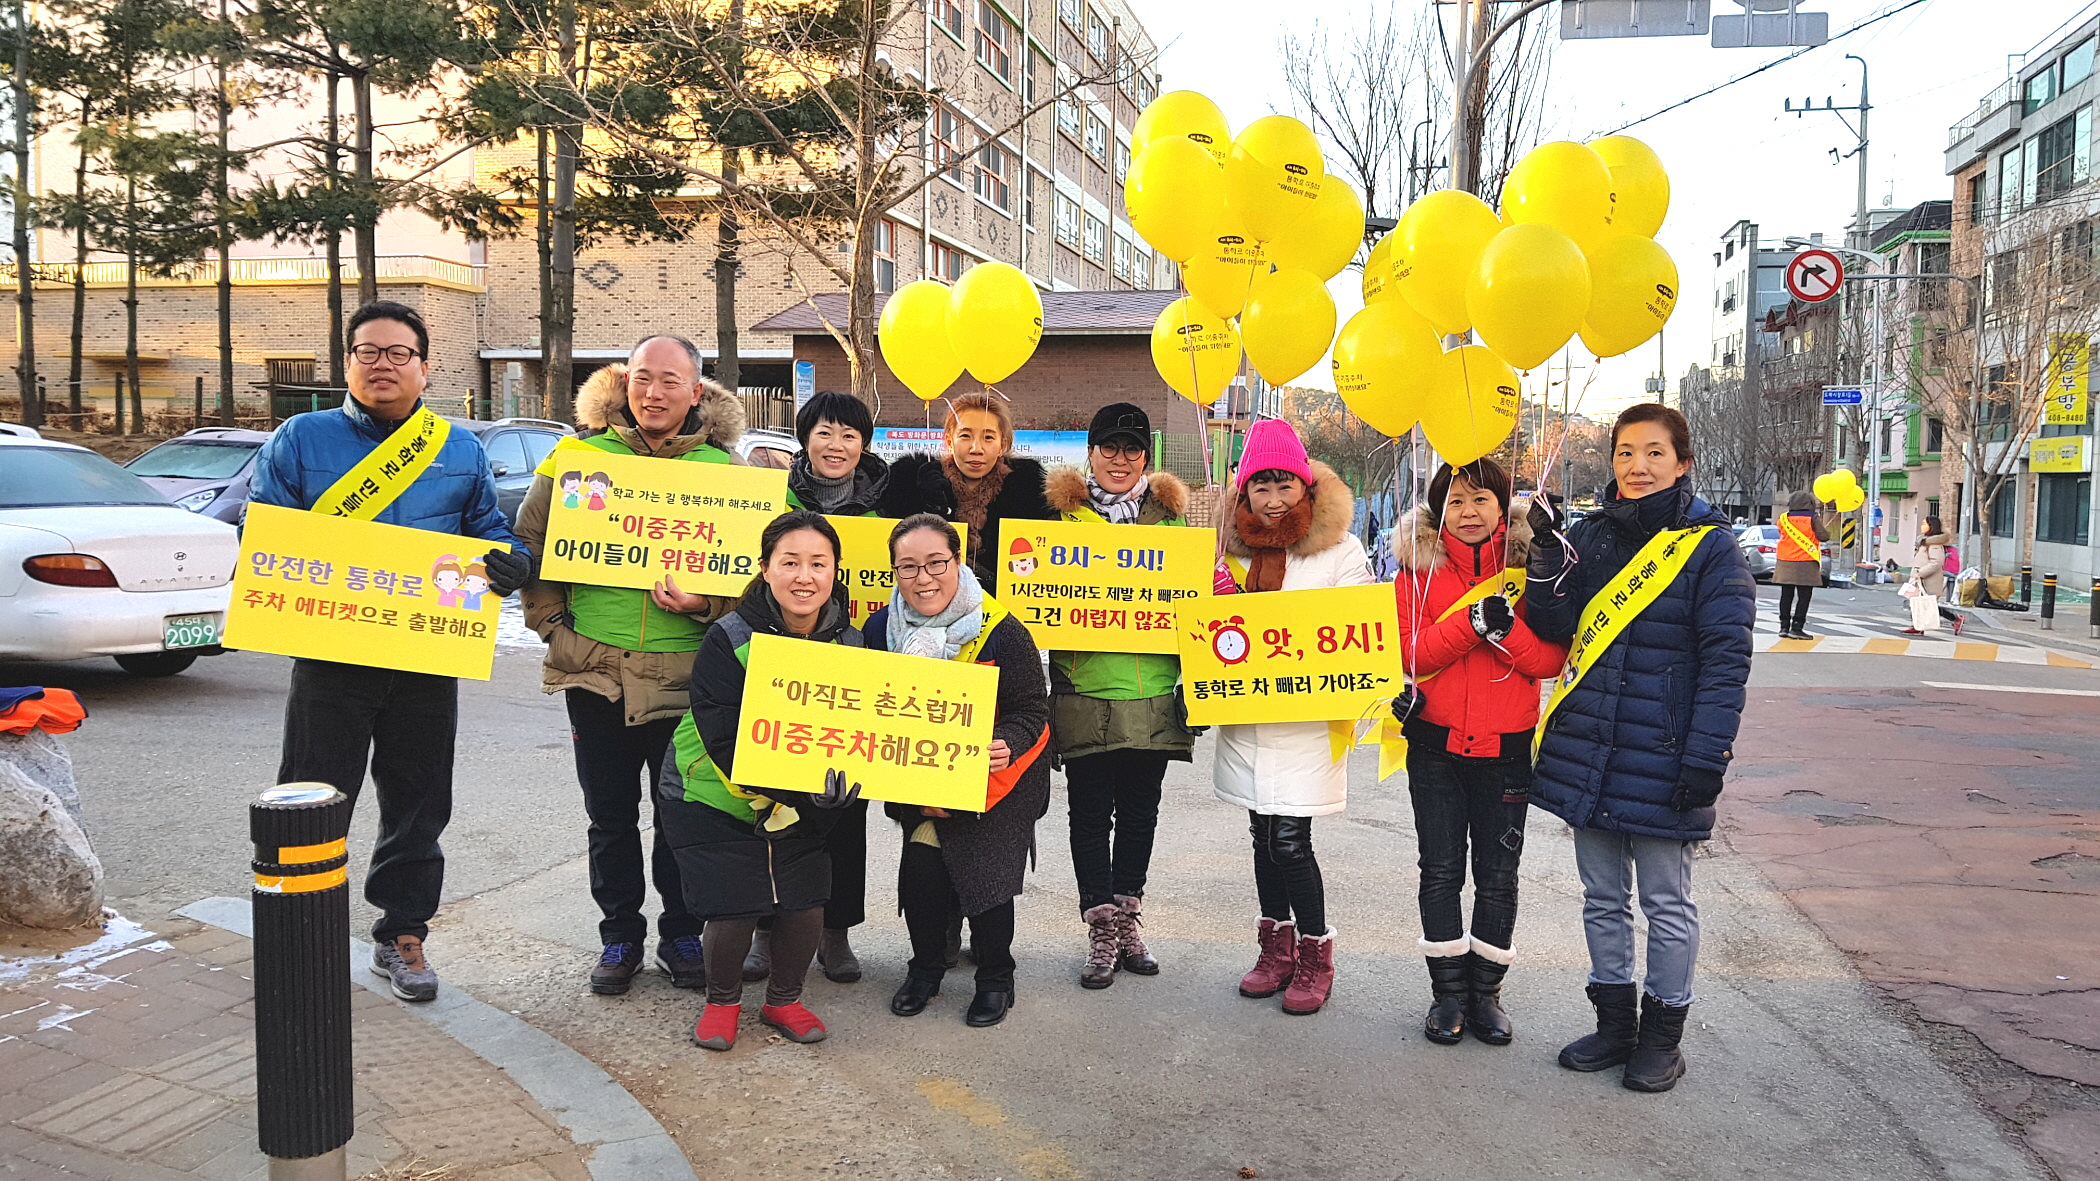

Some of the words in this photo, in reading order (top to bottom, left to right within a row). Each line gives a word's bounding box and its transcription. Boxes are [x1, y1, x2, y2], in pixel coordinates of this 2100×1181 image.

[379, 434, 428, 480] 통학로
[612, 487, 635, 500] 학교
[639, 490, 661, 503] 가는
[665, 492, 676, 504] 길
[680, 493, 725, 508] 행복하게
[728, 498, 773, 512] 해주세요
[554, 538, 649, 568] 아이들이
[1116, 548, 1164, 572] 9시!
[251, 551, 334, 585] 안전한
[345, 565, 424, 598] 통학로
[1610, 560, 1658, 610] 통학로
[1010, 583, 1101, 600] 1시간만이라도
[1106, 585, 1134, 602] 제발
[1139, 588, 1153, 603] 차
[243, 589, 286, 613] 주차
[295, 595, 398, 628] 에티켓으로
[408, 612, 488, 640] 출발해요
[1023, 607, 1062, 628] 그건
[1069, 608, 1126, 630] 어렵지
[167, 624, 214, 647] 2099
[1262, 628, 1305, 662] 앗,
[1317, 621, 1385, 655] 8시!
[771, 677, 862, 712] “아직도
[874, 691, 973, 728] 촌스럽게
[1193, 679, 1246, 701] 통학로
[1251, 678, 1270, 696] 차
[1276, 676, 1312, 697] 빼러
[1319, 673, 1391, 693] 가야죠~
[751, 718, 980, 772] 이중주차해요?”
